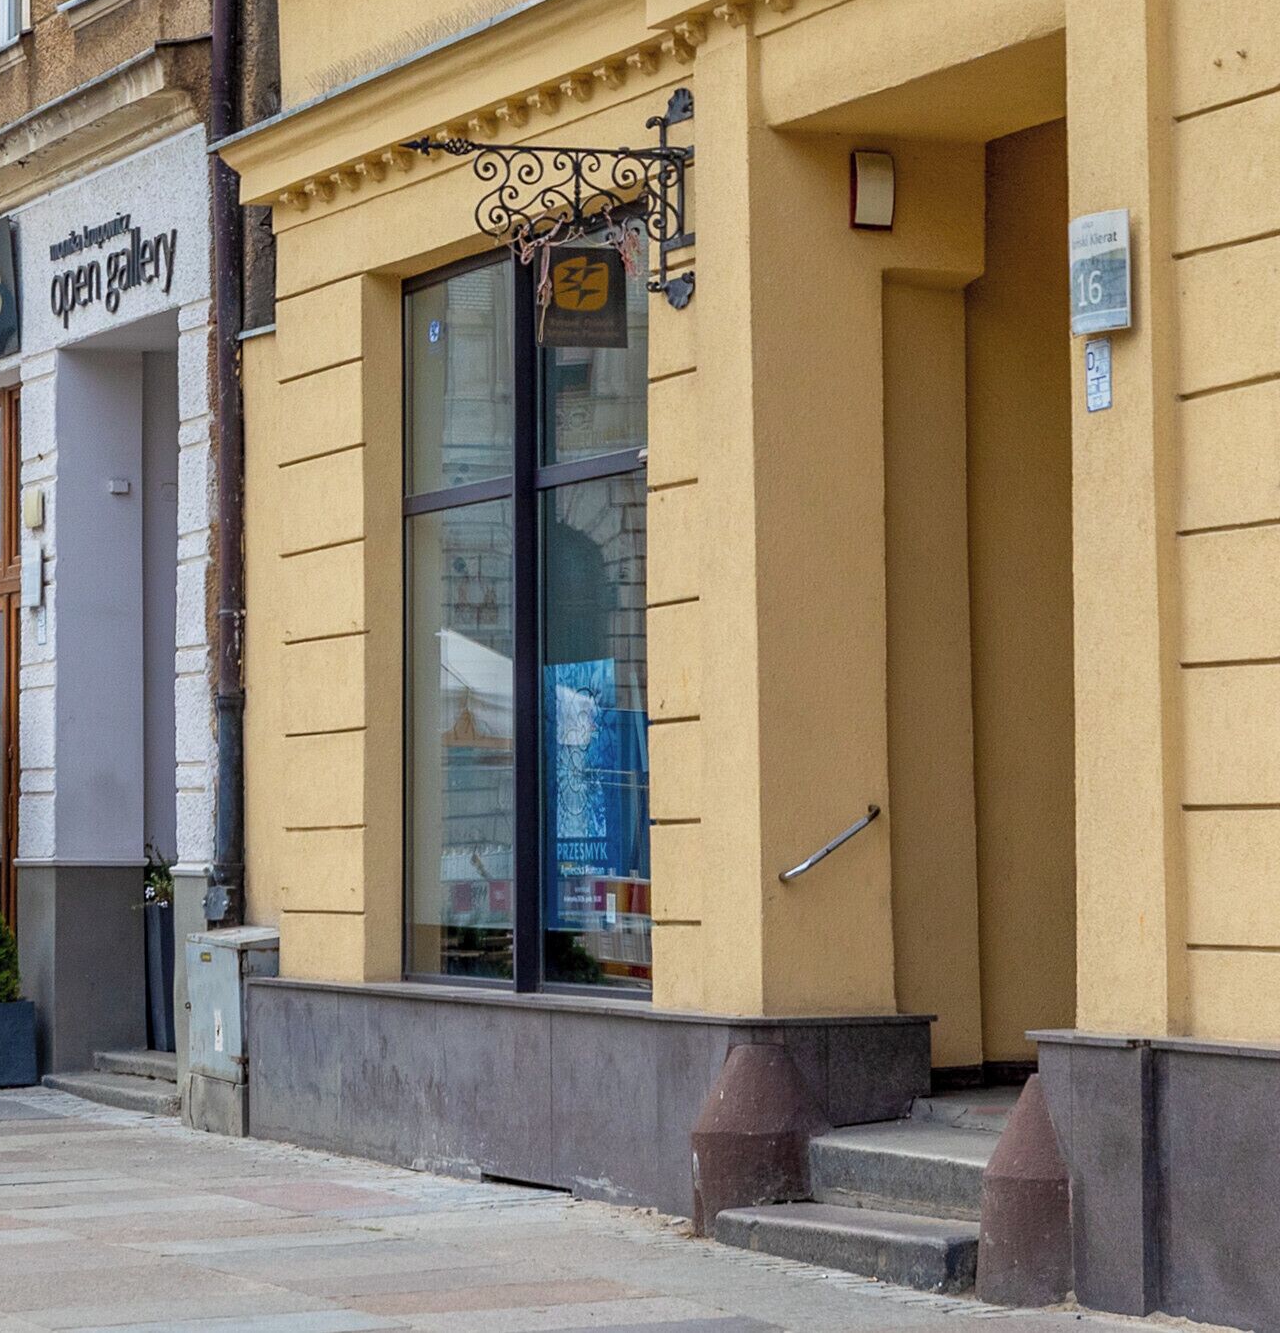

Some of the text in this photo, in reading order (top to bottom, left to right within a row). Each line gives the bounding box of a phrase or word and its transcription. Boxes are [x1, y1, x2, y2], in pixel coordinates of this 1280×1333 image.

[51, 227, 178, 329] open gallery
[1078, 270, 1103, 307] 16
[556, 842, 609, 861] PRZESMYK
